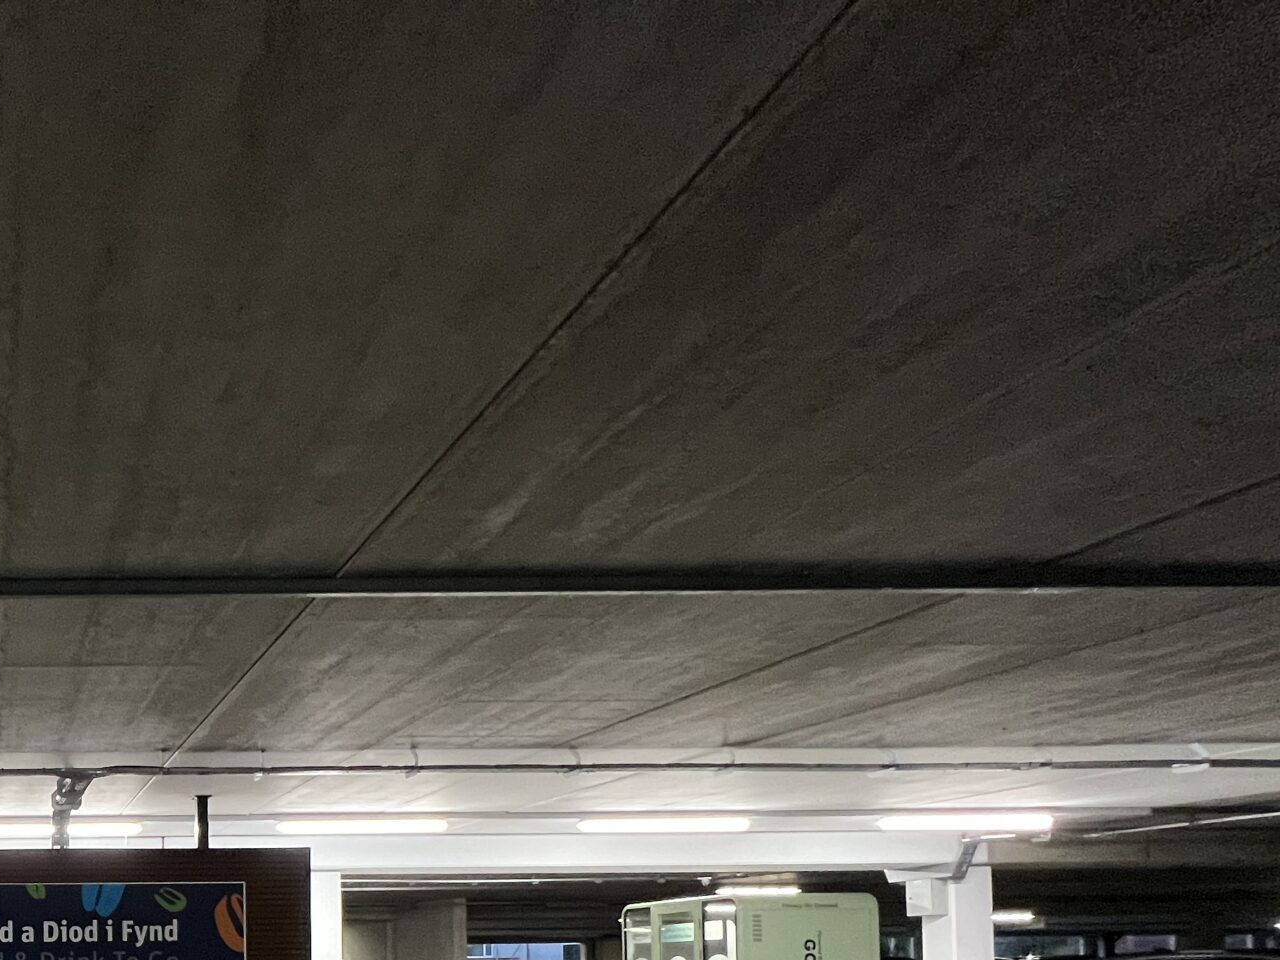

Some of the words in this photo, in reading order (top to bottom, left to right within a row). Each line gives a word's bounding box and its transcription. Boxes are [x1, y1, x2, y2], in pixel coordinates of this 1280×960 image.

[21, 926, 35, 943] a
[43, 919, 98, 943] Diod
[106, 919, 114, 942] i
[122, 918, 179, 948] Fynd
